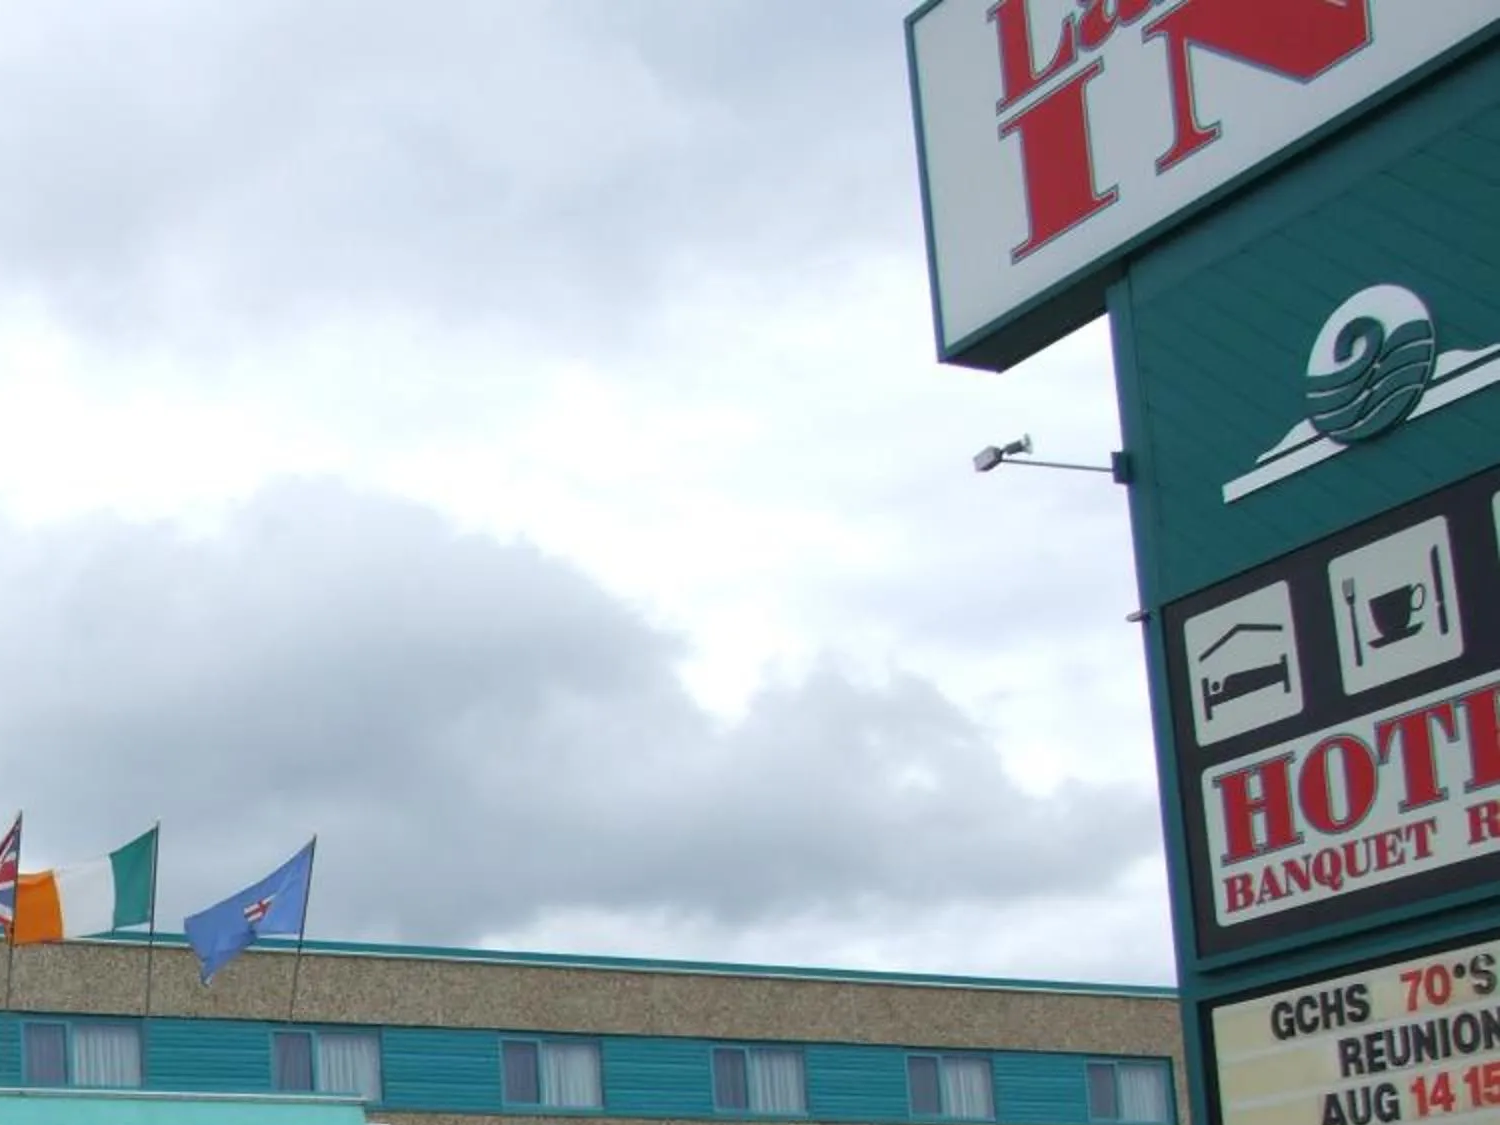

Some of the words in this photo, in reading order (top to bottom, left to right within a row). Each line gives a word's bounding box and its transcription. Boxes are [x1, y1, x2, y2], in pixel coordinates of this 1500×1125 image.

[1222, 817, 1438, 914] BANQUET
[1270, 983, 1371, 1041] GCHS
[1338, 1006, 1500, 1078] REUNION
[1409, 1071, 1457, 1119] 14
[1462, 1060, 1500, 1109] 15
